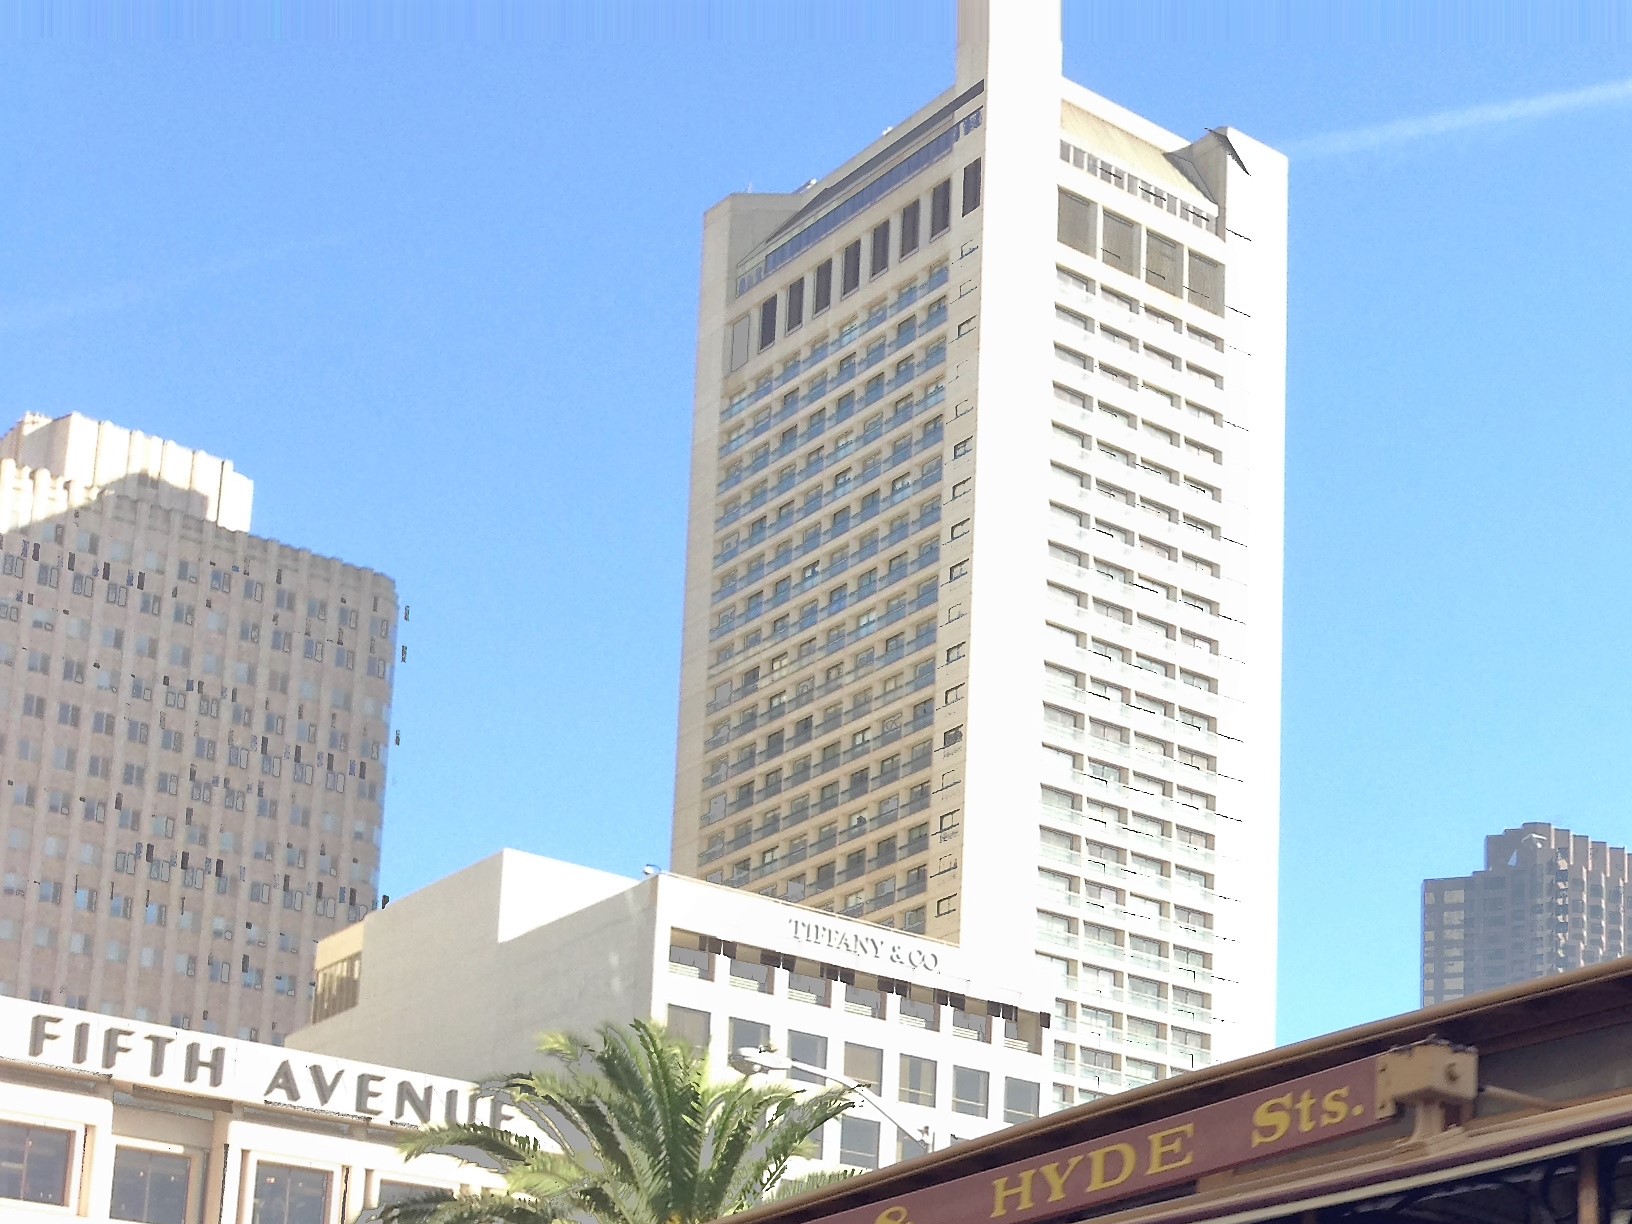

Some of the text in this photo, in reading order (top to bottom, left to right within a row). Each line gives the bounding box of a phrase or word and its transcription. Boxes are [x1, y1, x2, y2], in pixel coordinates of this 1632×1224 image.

[788, 918, 884, 959] TIFFANY
[889, 944, 904, 964] &
[28, 1013, 516, 1132] FIFTH AVENUE
[989, 1121, 1197, 1219] HYDE
[1250, 1078, 1365, 1147] Sts.
